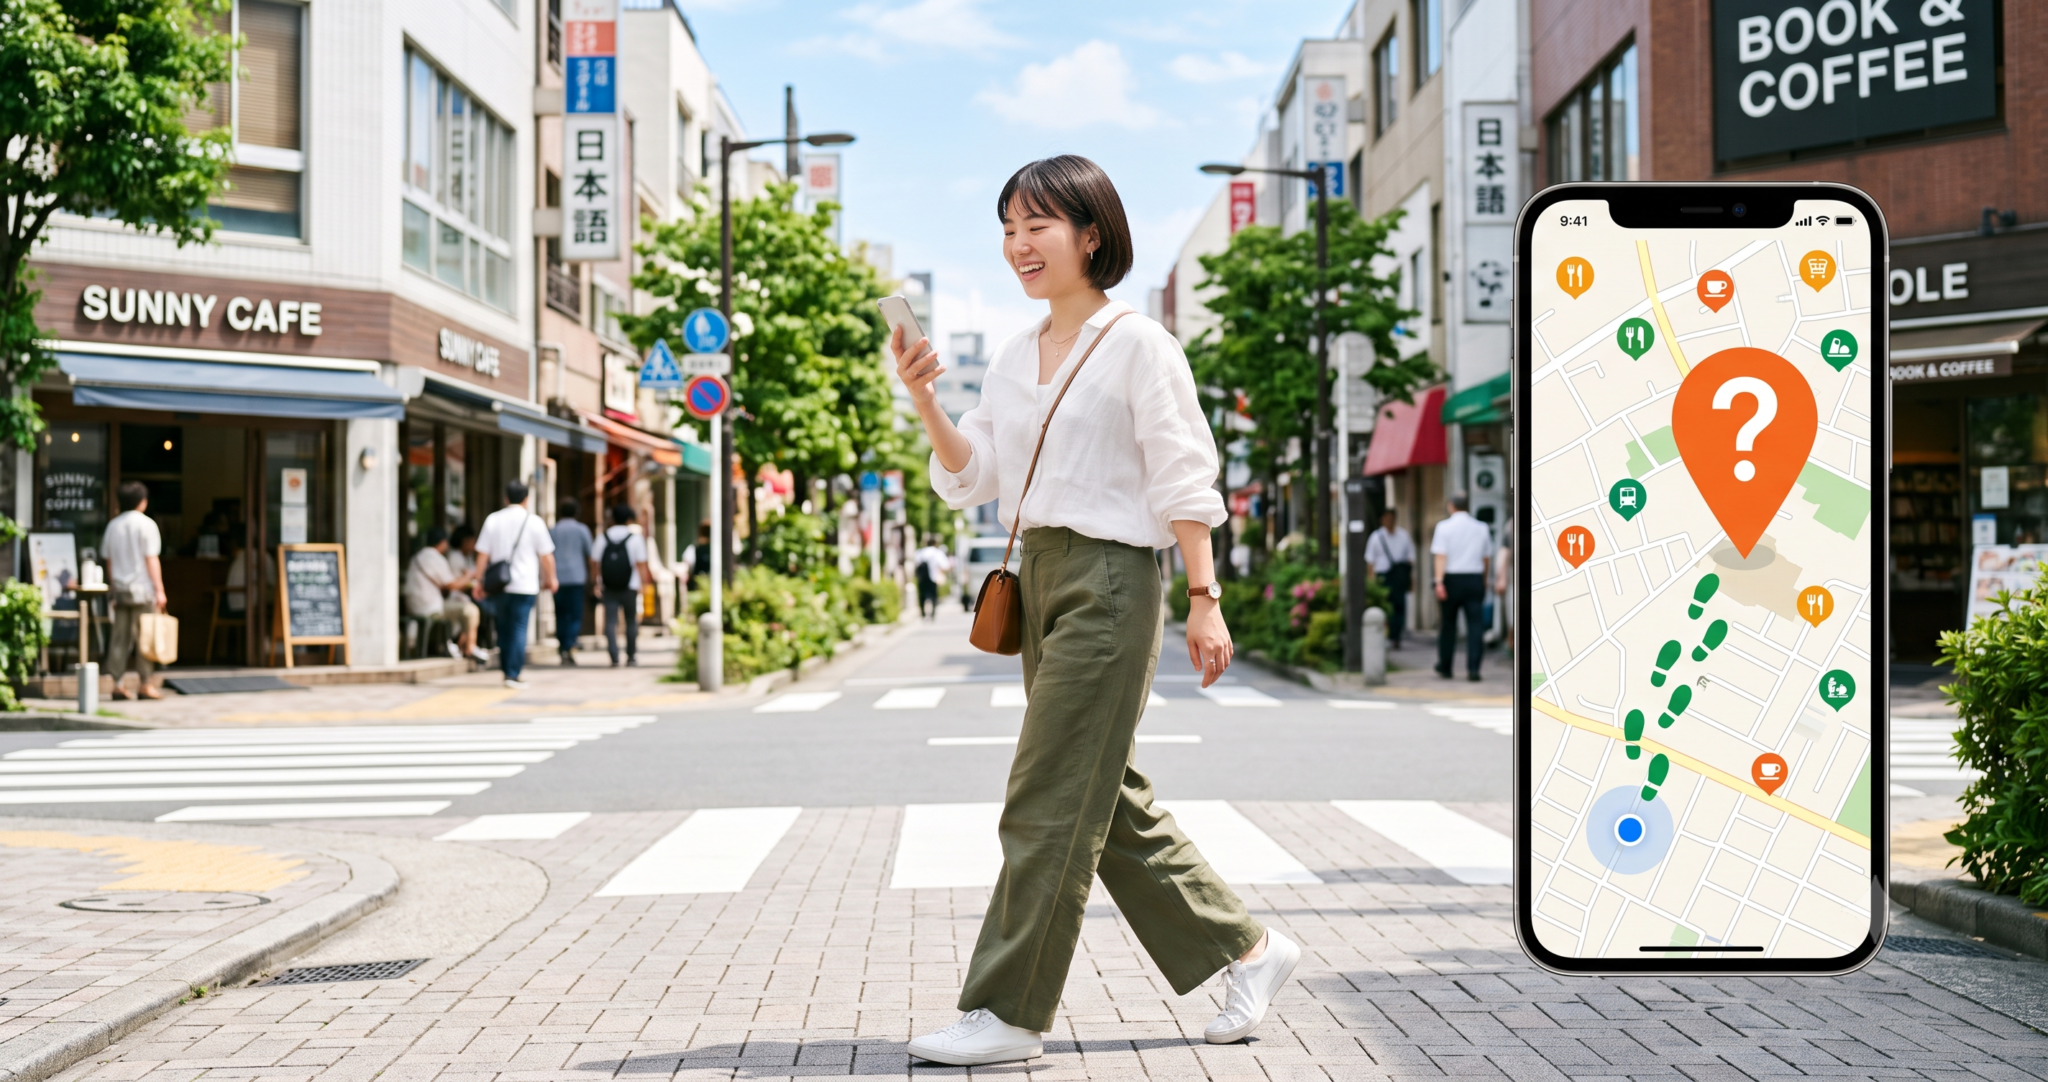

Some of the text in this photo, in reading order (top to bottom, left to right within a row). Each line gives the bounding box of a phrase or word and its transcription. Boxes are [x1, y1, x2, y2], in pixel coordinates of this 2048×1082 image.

[1738, 0, 1899, 63] BOOK
[1738, 32, 1968, 118] COFFEE
[573, 130, 607, 243] 日本語
[1560, 215, 1587, 227] 9:41
[82, 284, 322, 336] SUNNY CAFE
[1939, 359, 1995, 377] COFFEE
[44, 472, 96, 488] SUNNY
[44, 497, 95, 511] COFFEE
